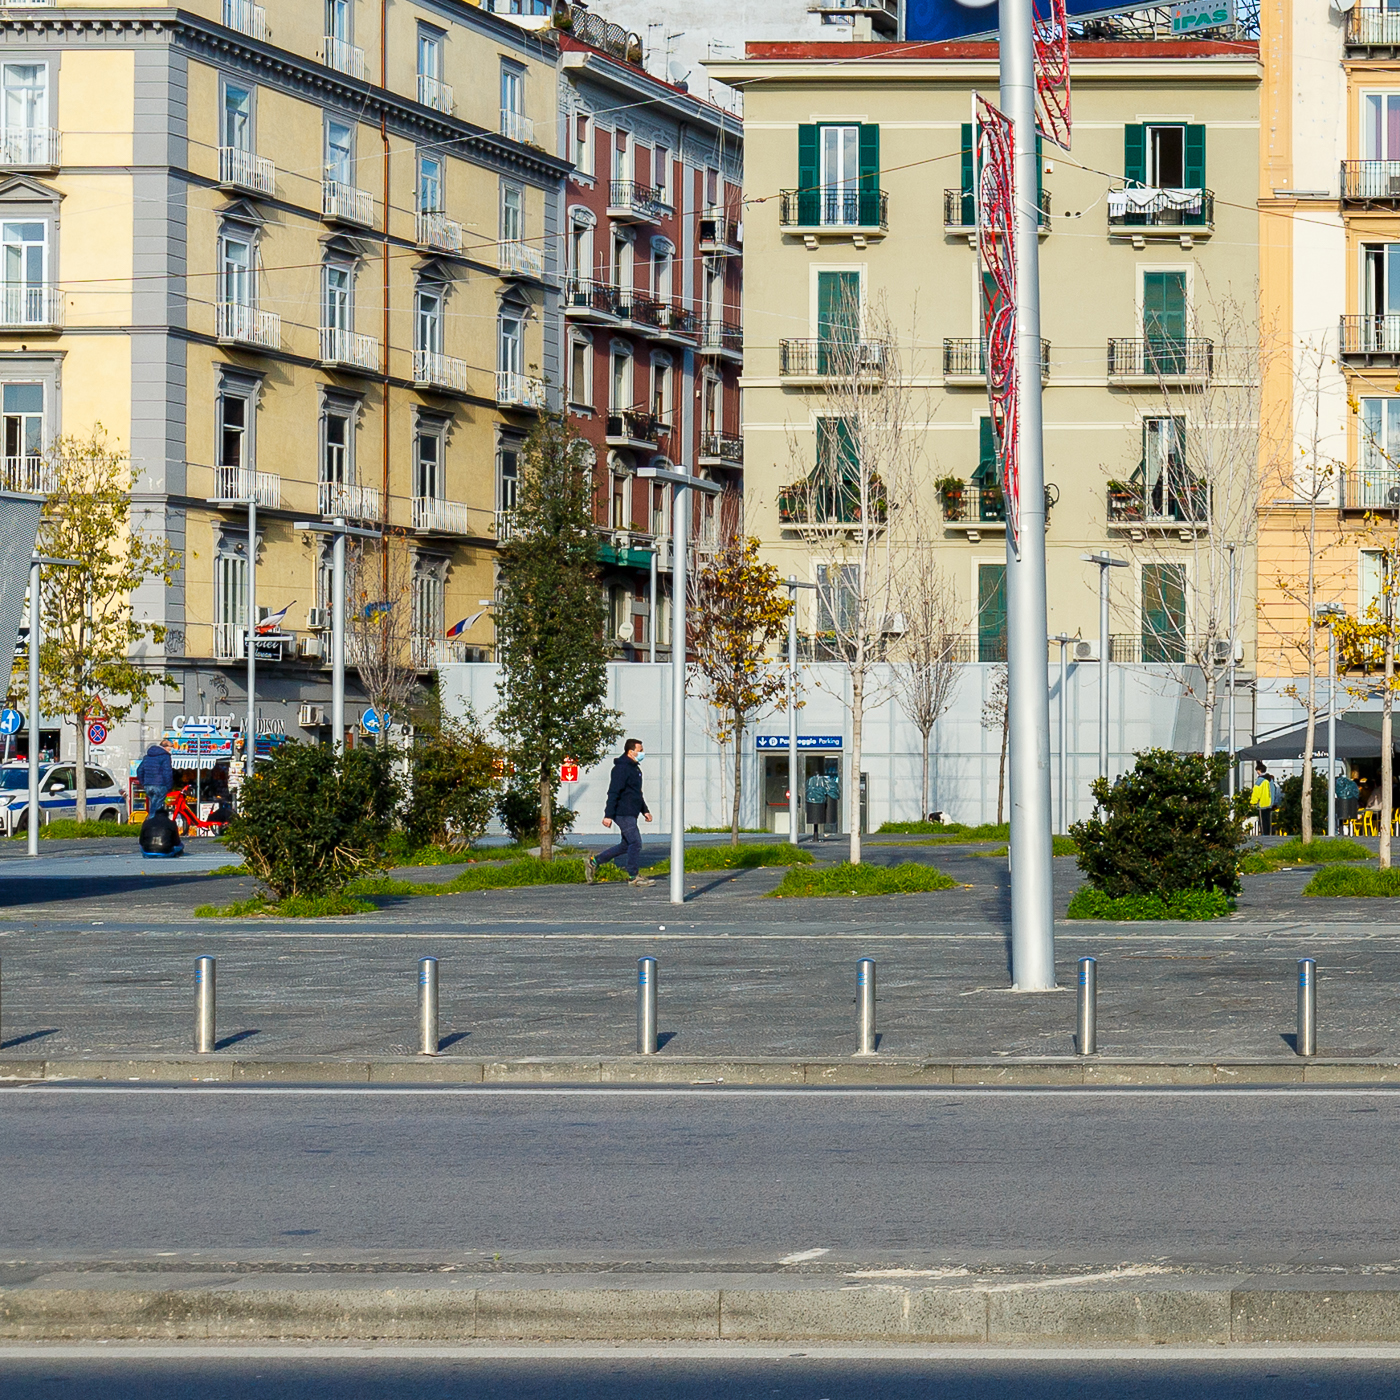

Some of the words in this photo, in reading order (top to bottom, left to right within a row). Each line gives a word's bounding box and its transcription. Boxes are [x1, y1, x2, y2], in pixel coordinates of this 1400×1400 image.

[240, 717, 286, 734] MDISON
[779, 737, 817, 746] Paeggio
[818, 737, 840, 746] Parking
